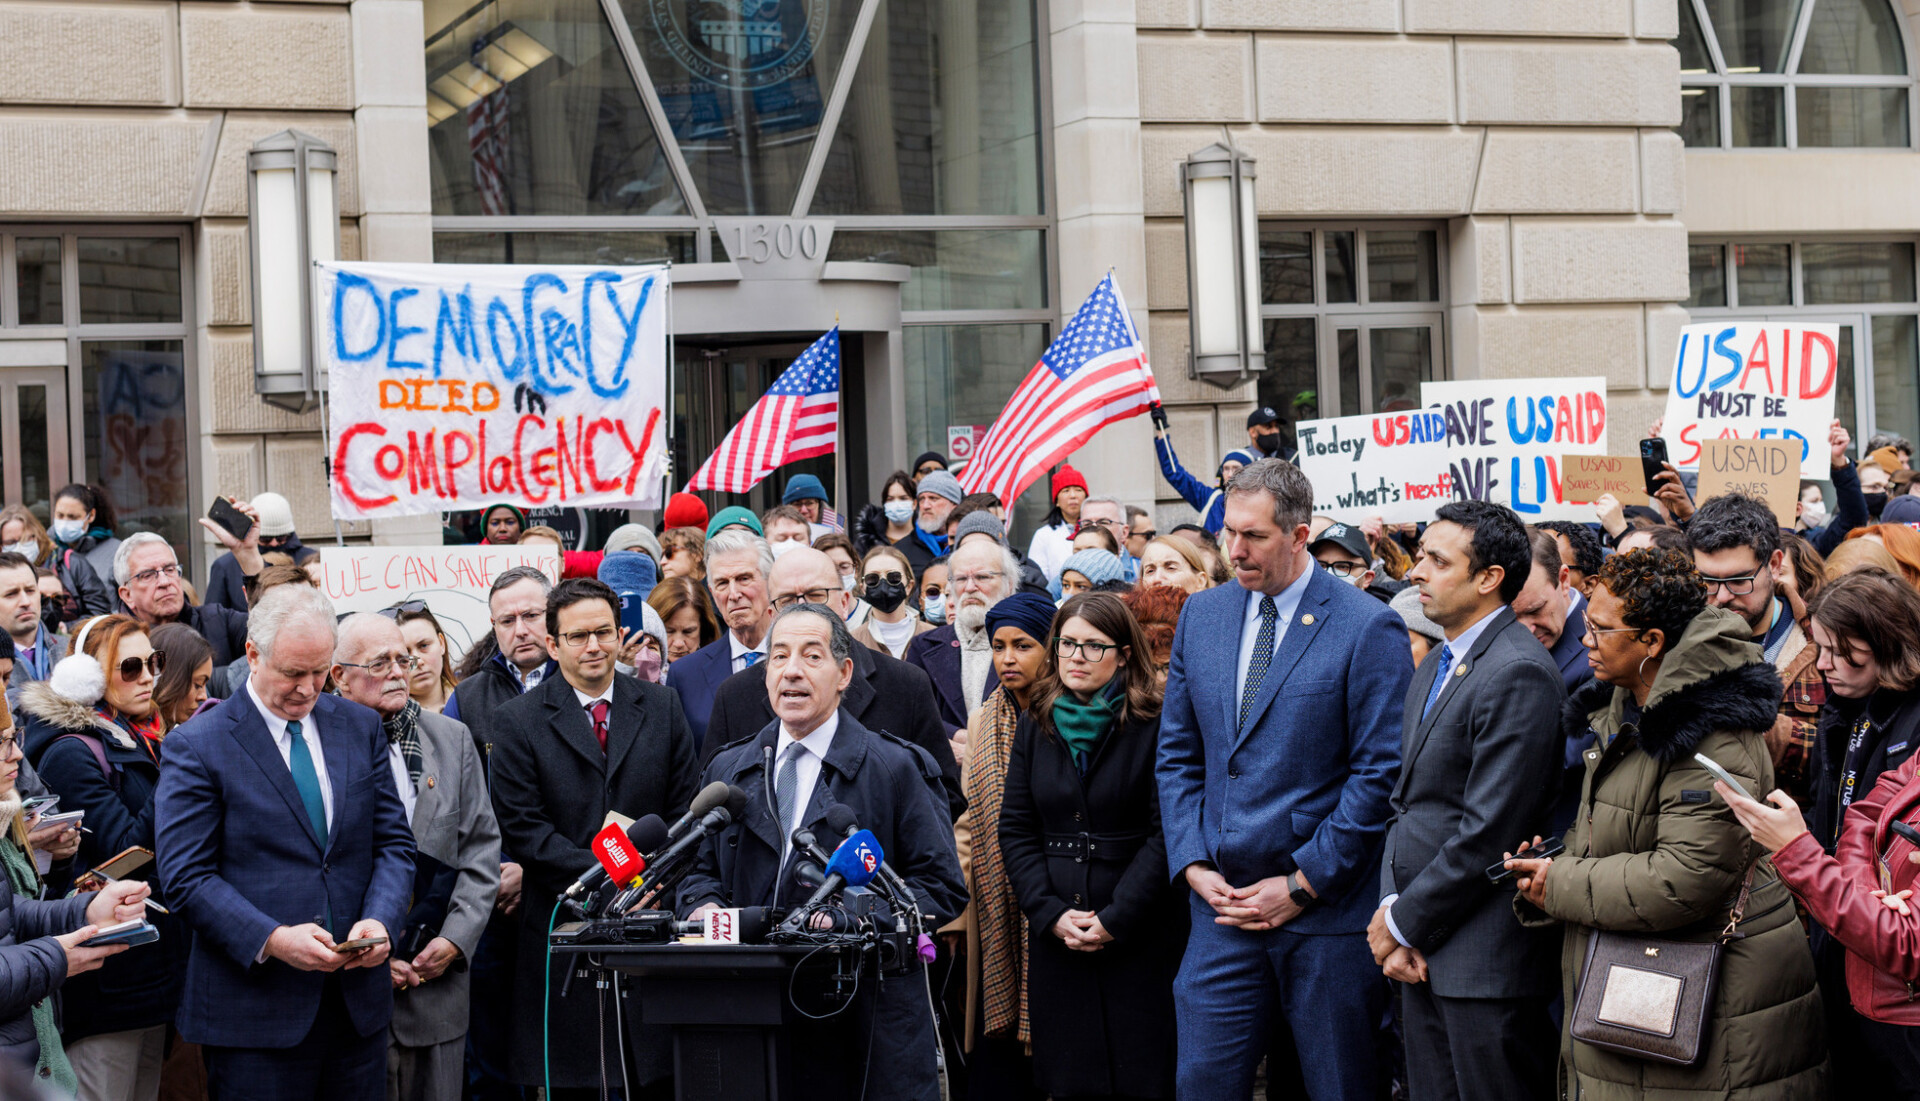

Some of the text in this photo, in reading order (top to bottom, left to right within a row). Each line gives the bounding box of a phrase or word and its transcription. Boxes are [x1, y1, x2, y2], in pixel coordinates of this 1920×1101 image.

[733, 223, 818, 264] 1300
[334, 270, 655, 400] DEMOCRACY
[1676, 326, 1838, 400] USAID
[378, 375, 501, 416] DIED
[1697, 391, 1788, 419] MUST BE
[1430, 391, 1606, 448] AVE USAID
[1298, 413, 1446, 462] Today USAID
[1580, 457, 1622, 473] USAID
[1712, 444, 1788, 476] USAID
[1404, 472, 1453, 500] next?
[1450, 456, 1499, 502] AVE
[1566, 474, 1600, 491] Saves
[1724, 481, 1769, 494] SAVES
[324, 555, 377, 600] WE
[384, 554, 438, 590] CAN
[445, 553, 497, 589] SAVE
[1843, 770, 1856, 806] NOTUS
[711, 911, 720, 941] NEWS
[722, 911, 732, 941] CTV
[1644, 946, 1660, 957] MK
